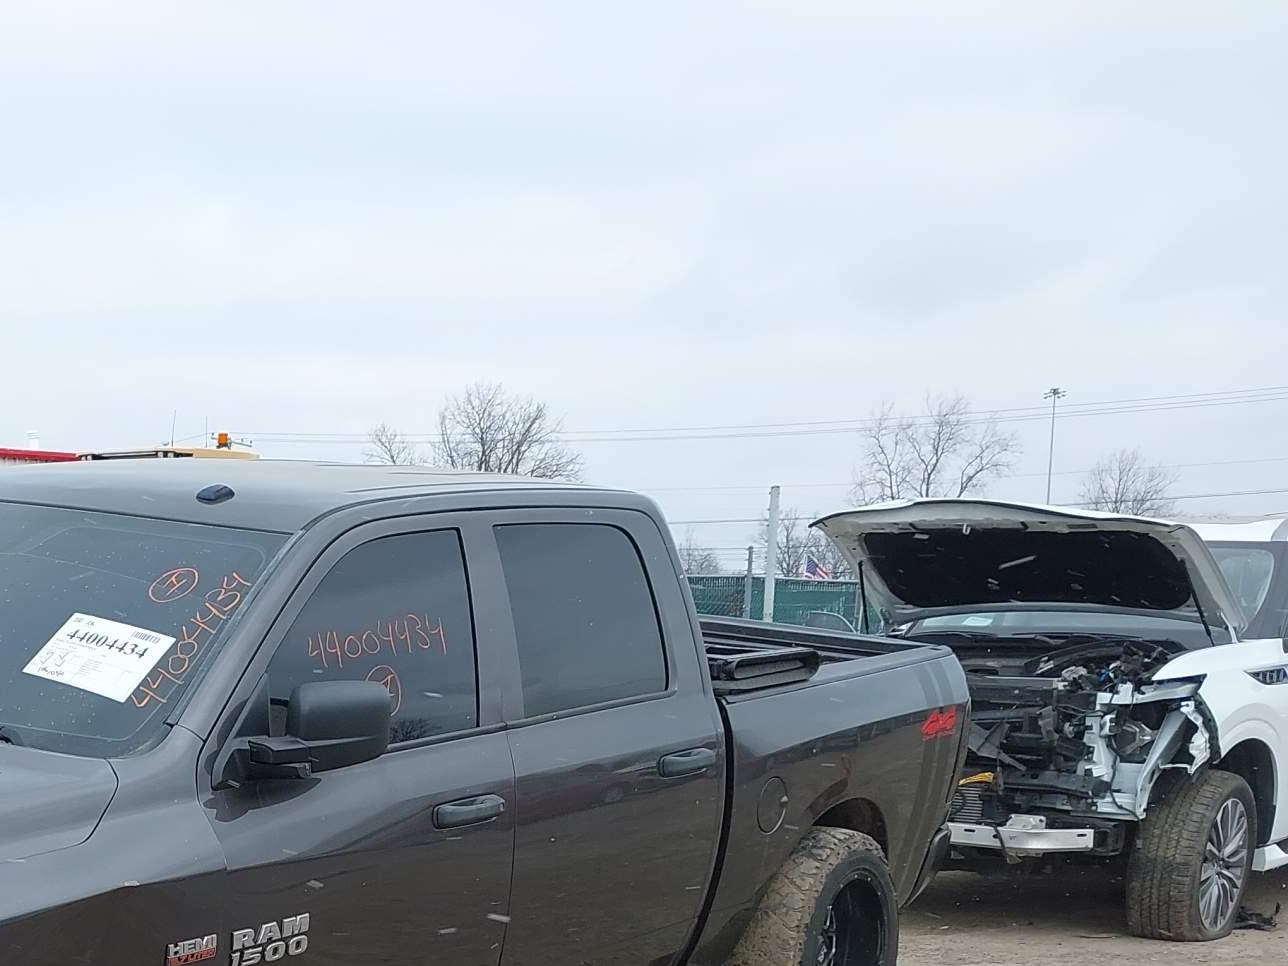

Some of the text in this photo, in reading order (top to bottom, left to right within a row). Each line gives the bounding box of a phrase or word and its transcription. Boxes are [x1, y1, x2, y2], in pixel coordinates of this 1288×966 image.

[66, 628, 149, 659] 44004434
[131, 572, 252, 707] 44004434
[307, 613, 447, 669] 44004434
[167, 933, 218, 958] HEMI
[231, 912, 311, 951] RAM
